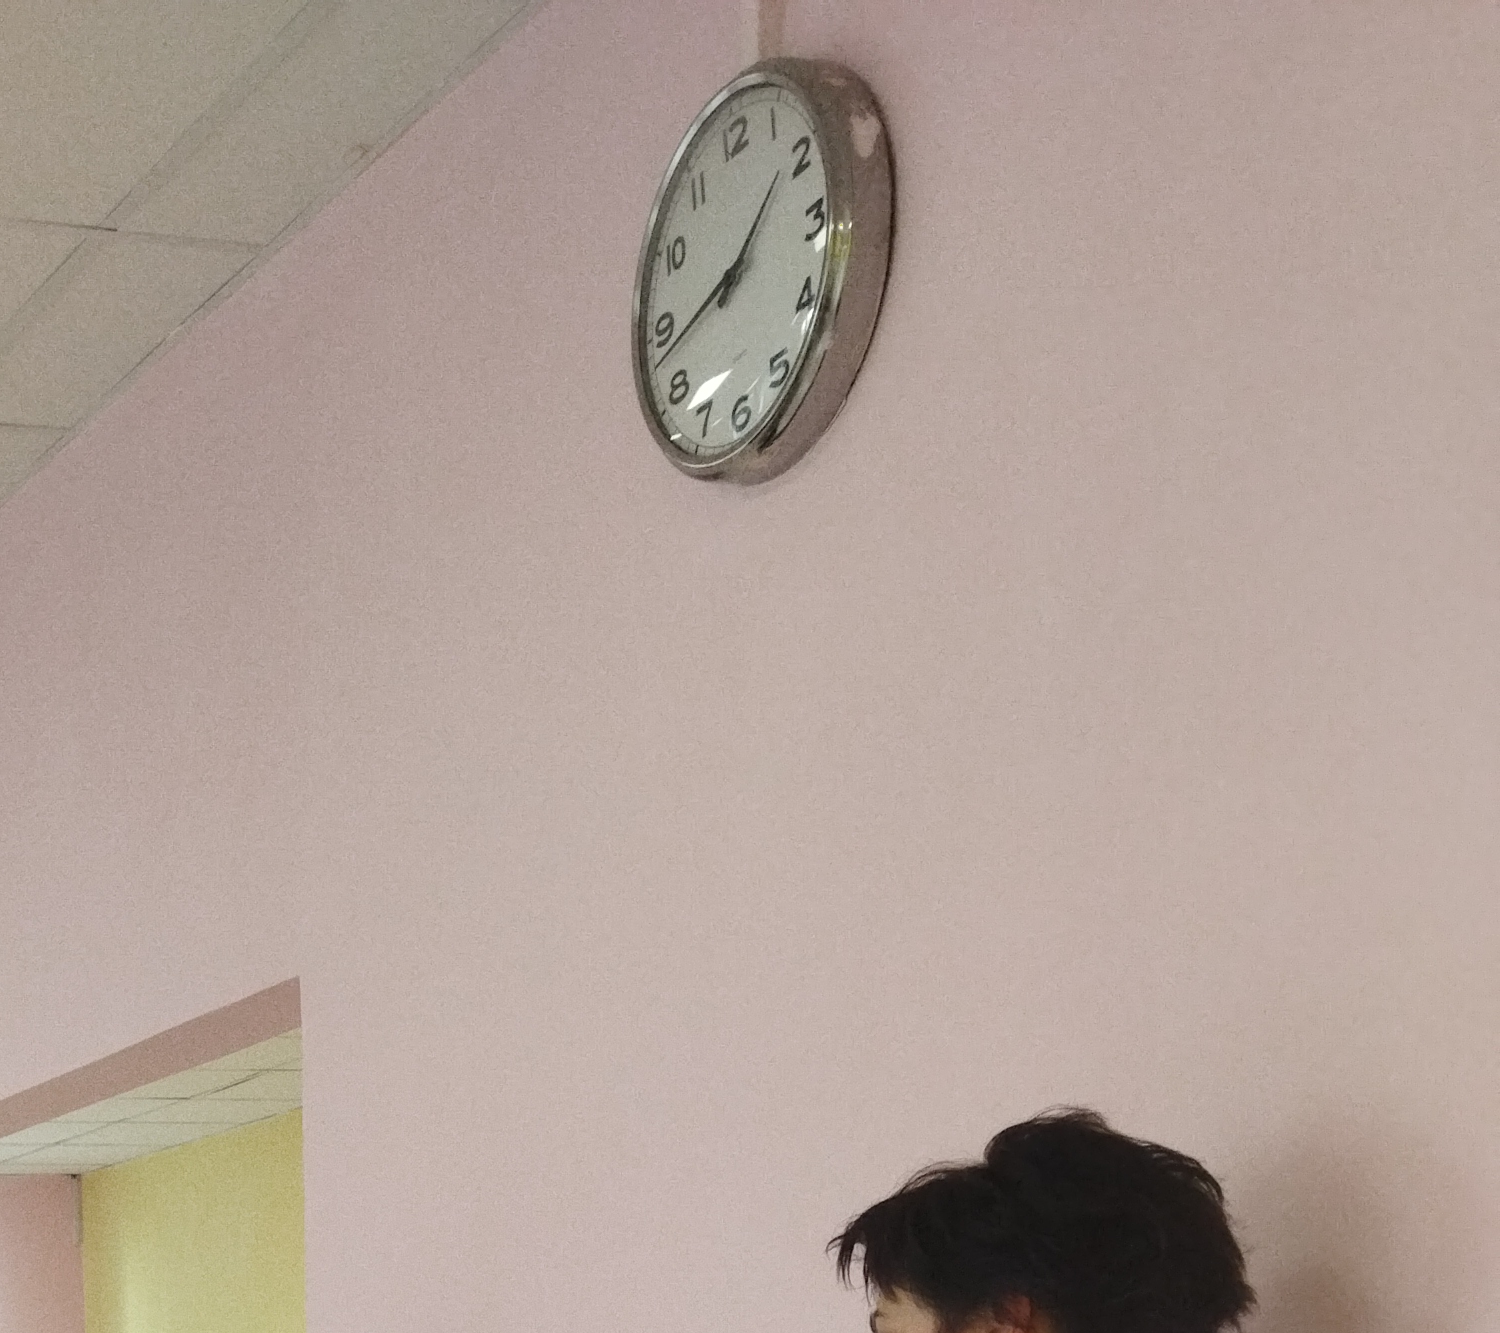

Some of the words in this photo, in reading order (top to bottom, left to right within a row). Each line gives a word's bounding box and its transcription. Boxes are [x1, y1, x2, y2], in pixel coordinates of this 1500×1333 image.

[724, 115, 750, 163] 12
[771, 107, 778, 141] 1
[792, 136, 811, 180] 2
[691, 170, 706, 211] 11
[805, 197, 825, 242] 3
[666, 236, 686, 276] 10
[795, 275, 814, 315] 4
[654, 311, 675, 349] 9
[668, 368, 690, 405] 8
[769, 347, 790, 389] 5
[696, 399, 715, 438] 7
[730, 395, 752, 433] 6
